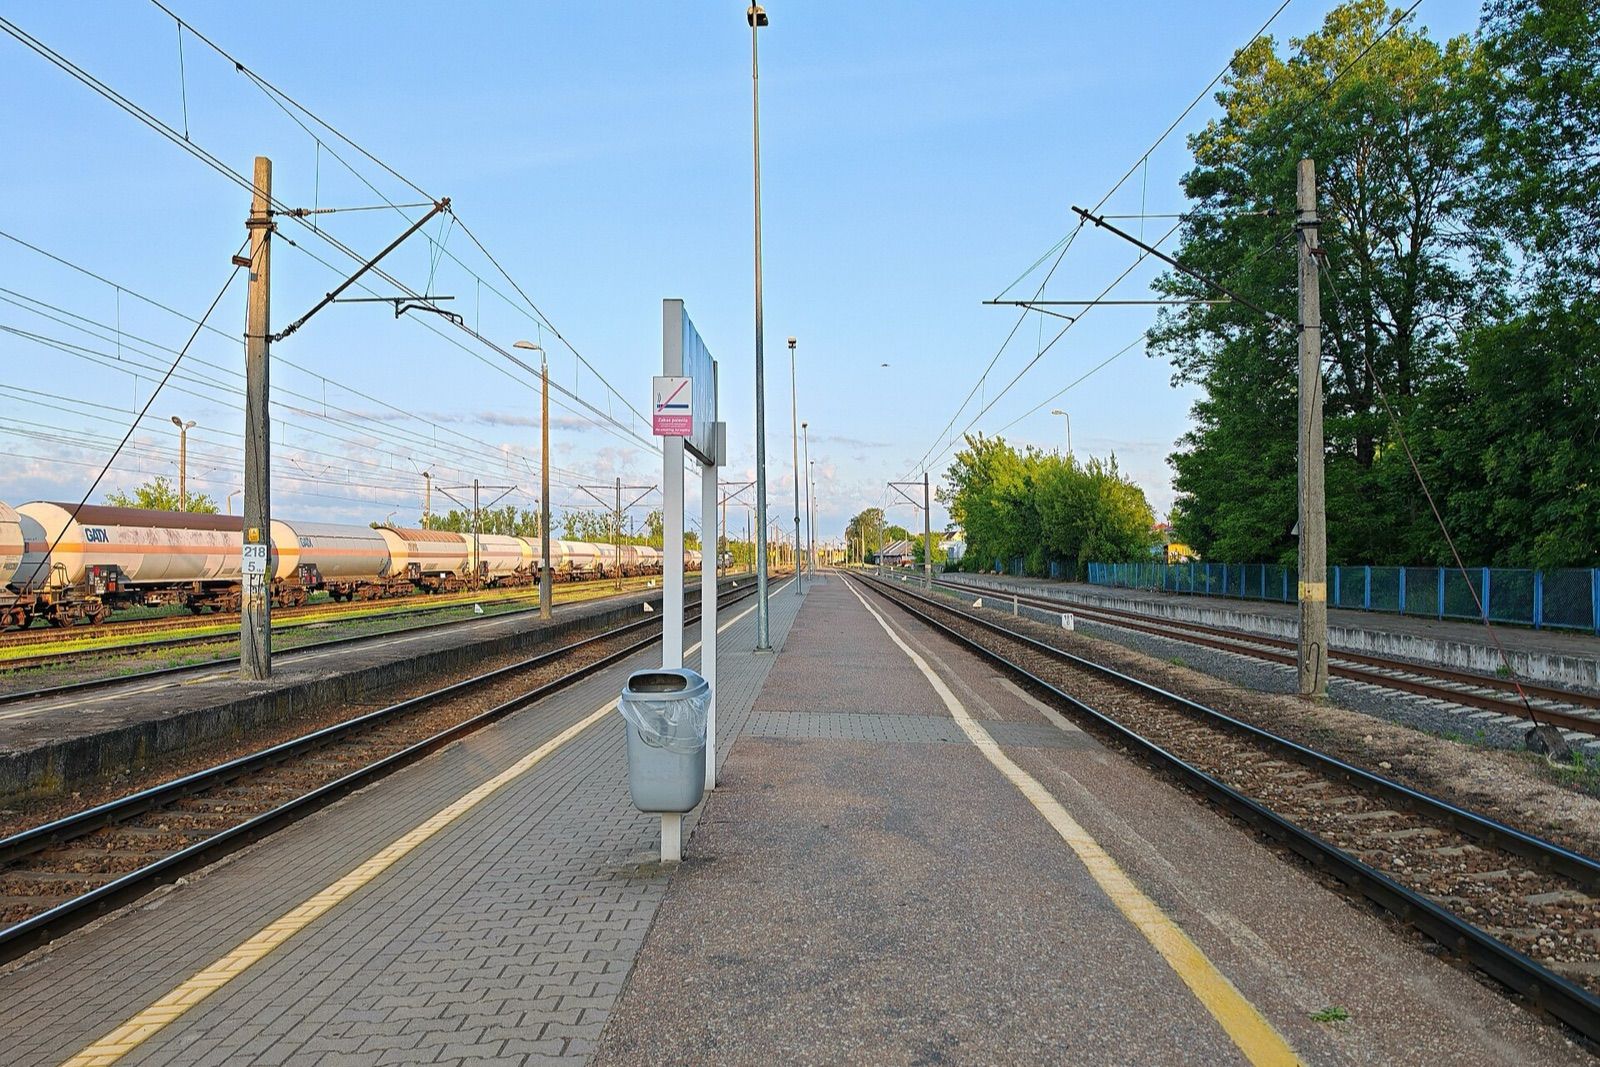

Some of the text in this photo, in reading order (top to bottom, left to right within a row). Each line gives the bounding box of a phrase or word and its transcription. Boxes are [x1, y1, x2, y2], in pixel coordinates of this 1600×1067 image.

[84, 527, 109, 543] GATX
[244, 546, 266, 558] 218
[248, 561, 256, 572] 5
